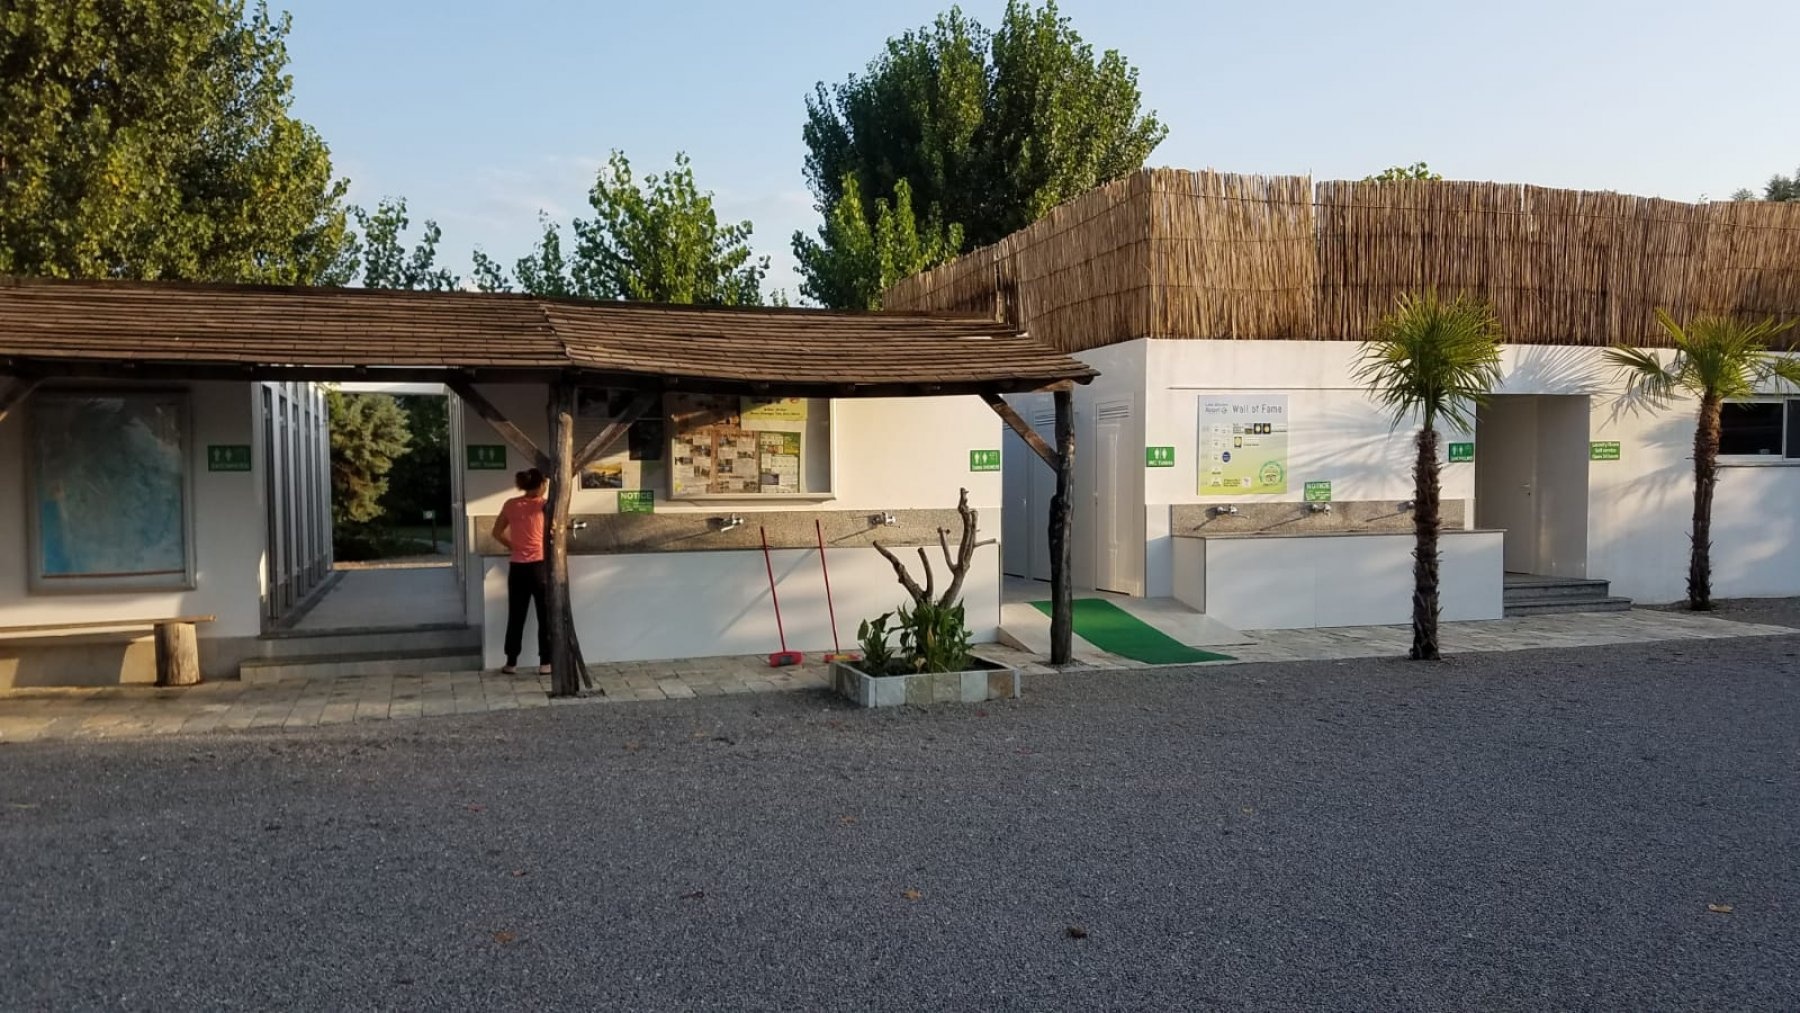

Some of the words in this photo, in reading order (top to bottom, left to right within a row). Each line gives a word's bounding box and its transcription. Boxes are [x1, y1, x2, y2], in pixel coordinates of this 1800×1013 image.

[1232, 404, 1249, 414] Wall
[1251, 404, 1259, 414] of
[1261, 404, 1282, 414] Fame
[620, 492, 653, 500] NOTICE
